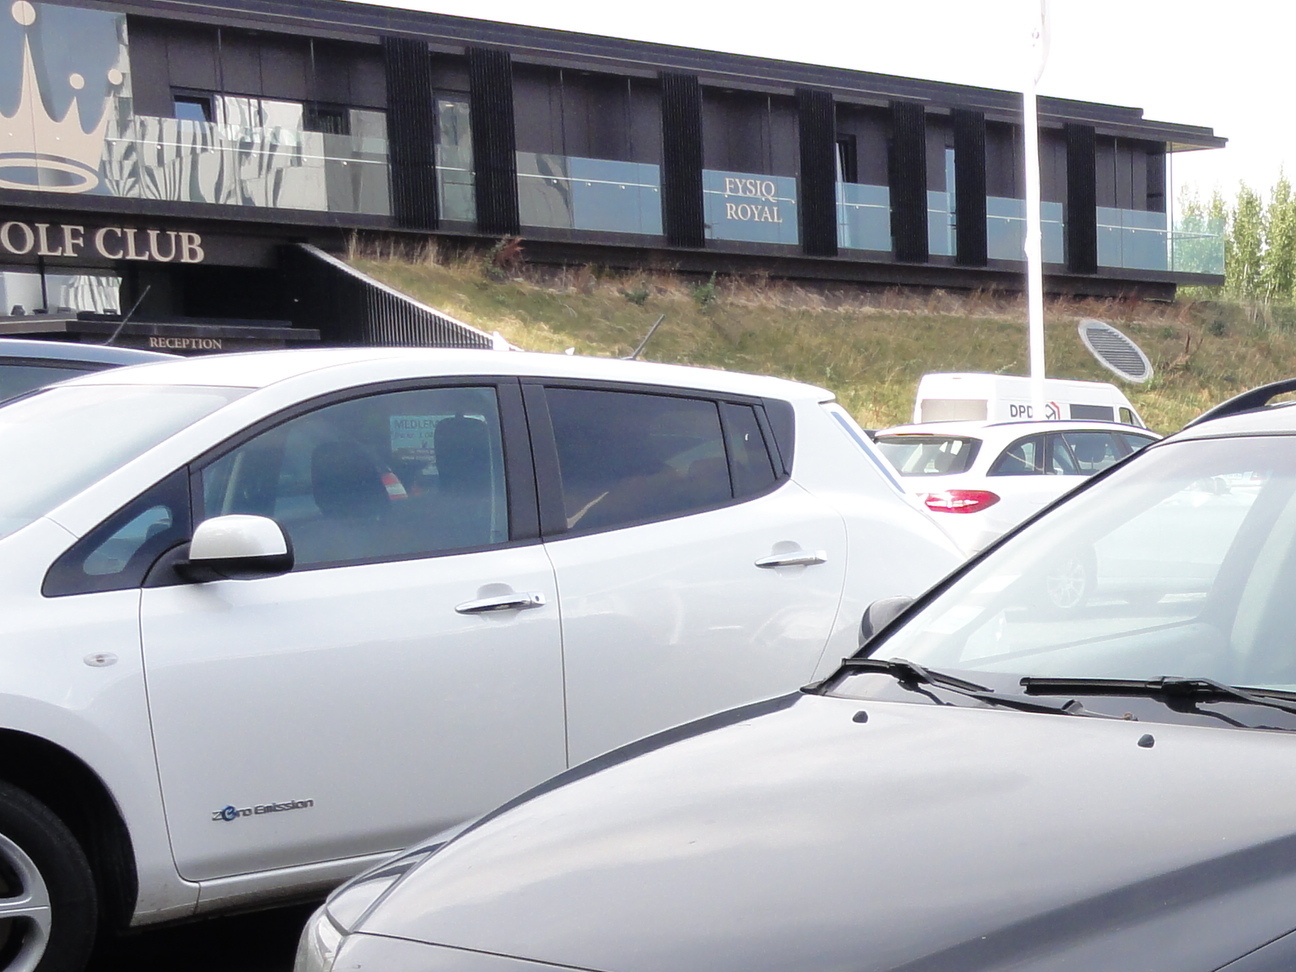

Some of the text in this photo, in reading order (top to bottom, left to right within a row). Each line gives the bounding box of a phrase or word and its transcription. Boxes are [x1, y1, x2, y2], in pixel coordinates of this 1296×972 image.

[725, 177, 777, 202] FYSIQ
[726, 203, 783, 223] ROYAL
[1, 221, 205, 263] OLF CLUB
[150, 337, 222, 349] RECEPTION
[1010, 404, 1033, 419] DPD
[254, 799, 314, 815] Emission
